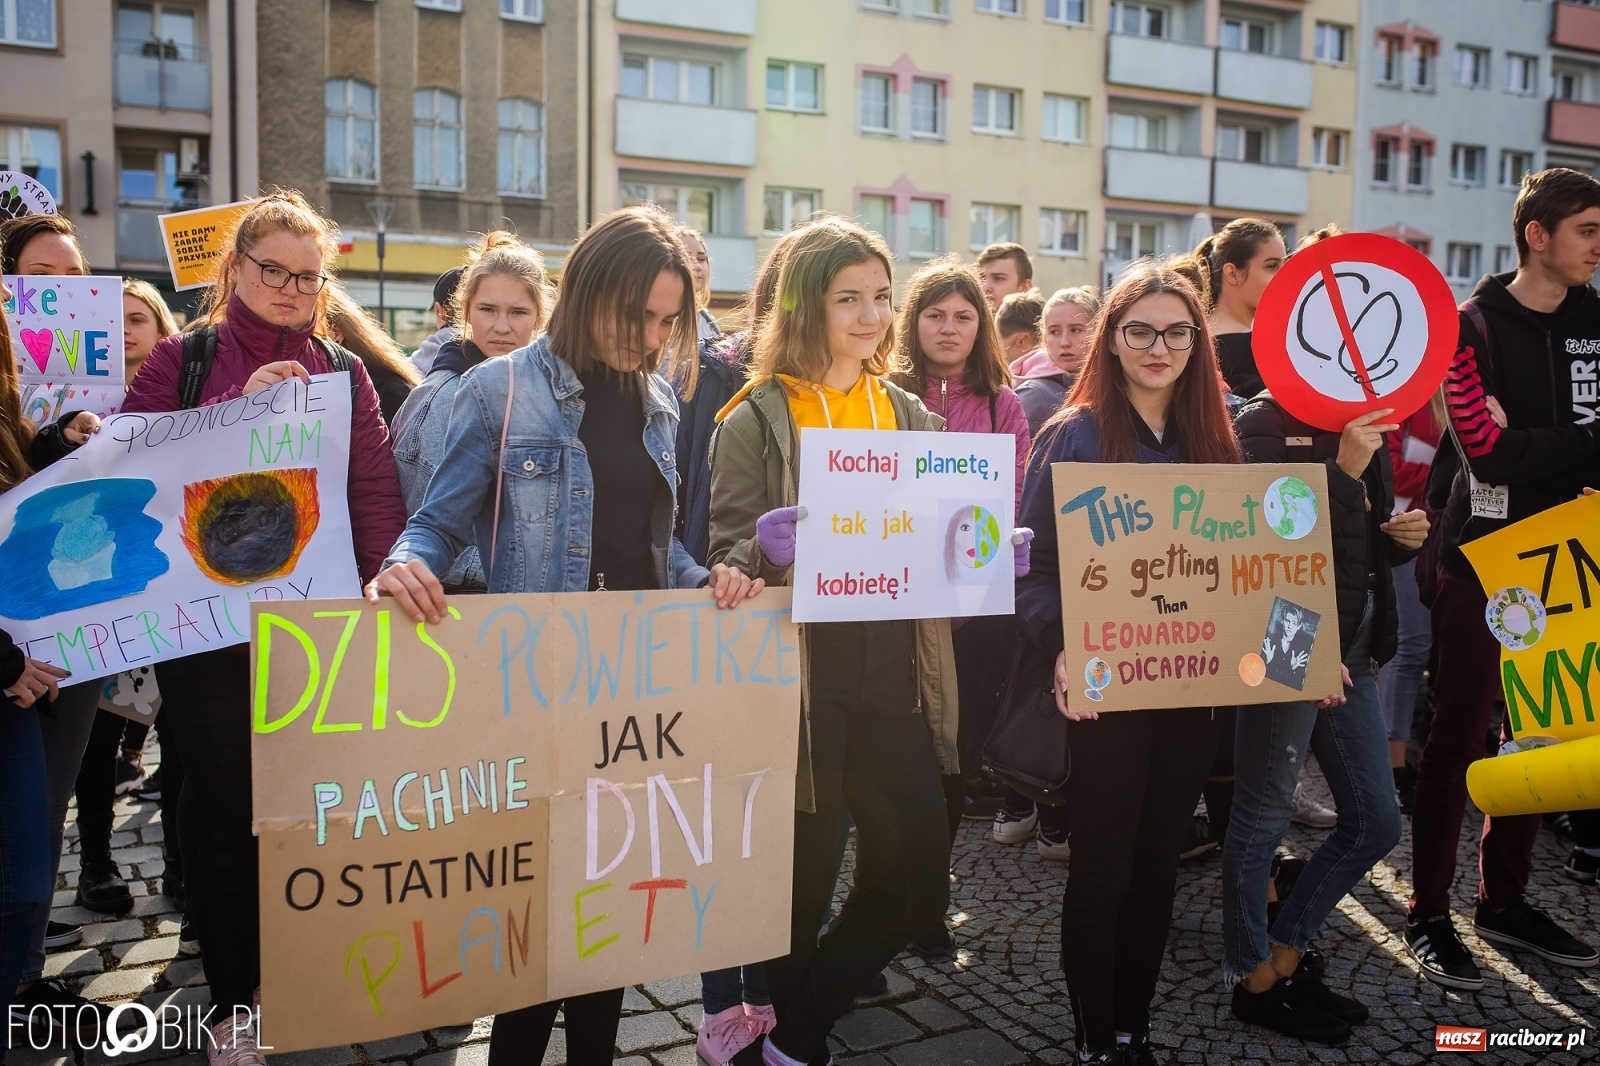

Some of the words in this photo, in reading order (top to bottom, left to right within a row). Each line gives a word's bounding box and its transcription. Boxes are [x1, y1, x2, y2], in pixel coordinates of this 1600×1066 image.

[172, 230, 190, 239] NIE
[191, 225, 217, 236] DAMY
[174, 234, 210, 247] ZABRAĆ
[176, 244, 205, 255] SOBIE
[249, 419, 322, 467] NAM
[828, 449, 899, 481] Kochaj
[915, 450, 1000, 481] planetę,
[831, 510, 868, 535] tak
[882, 509, 915, 540] jak
[1172, 484, 1260, 542] Planet
[816, 567, 910, 600] kobietę!
[1080, 558, 1109, 592] is
[1130, 543, 1220, 598] getting
[1231, 552, 1328, 597] HOTTER
[1151, 595, 1188, 615] Than
[1084, 621, 1216, 652] LEONARDO
[1503, 641, 1600, 733] MY
[313, 757, 529, 846] PACHNIE
[594, 711, 685, 769] JAK
[285, 842, 535, 912] OSTATNIE
